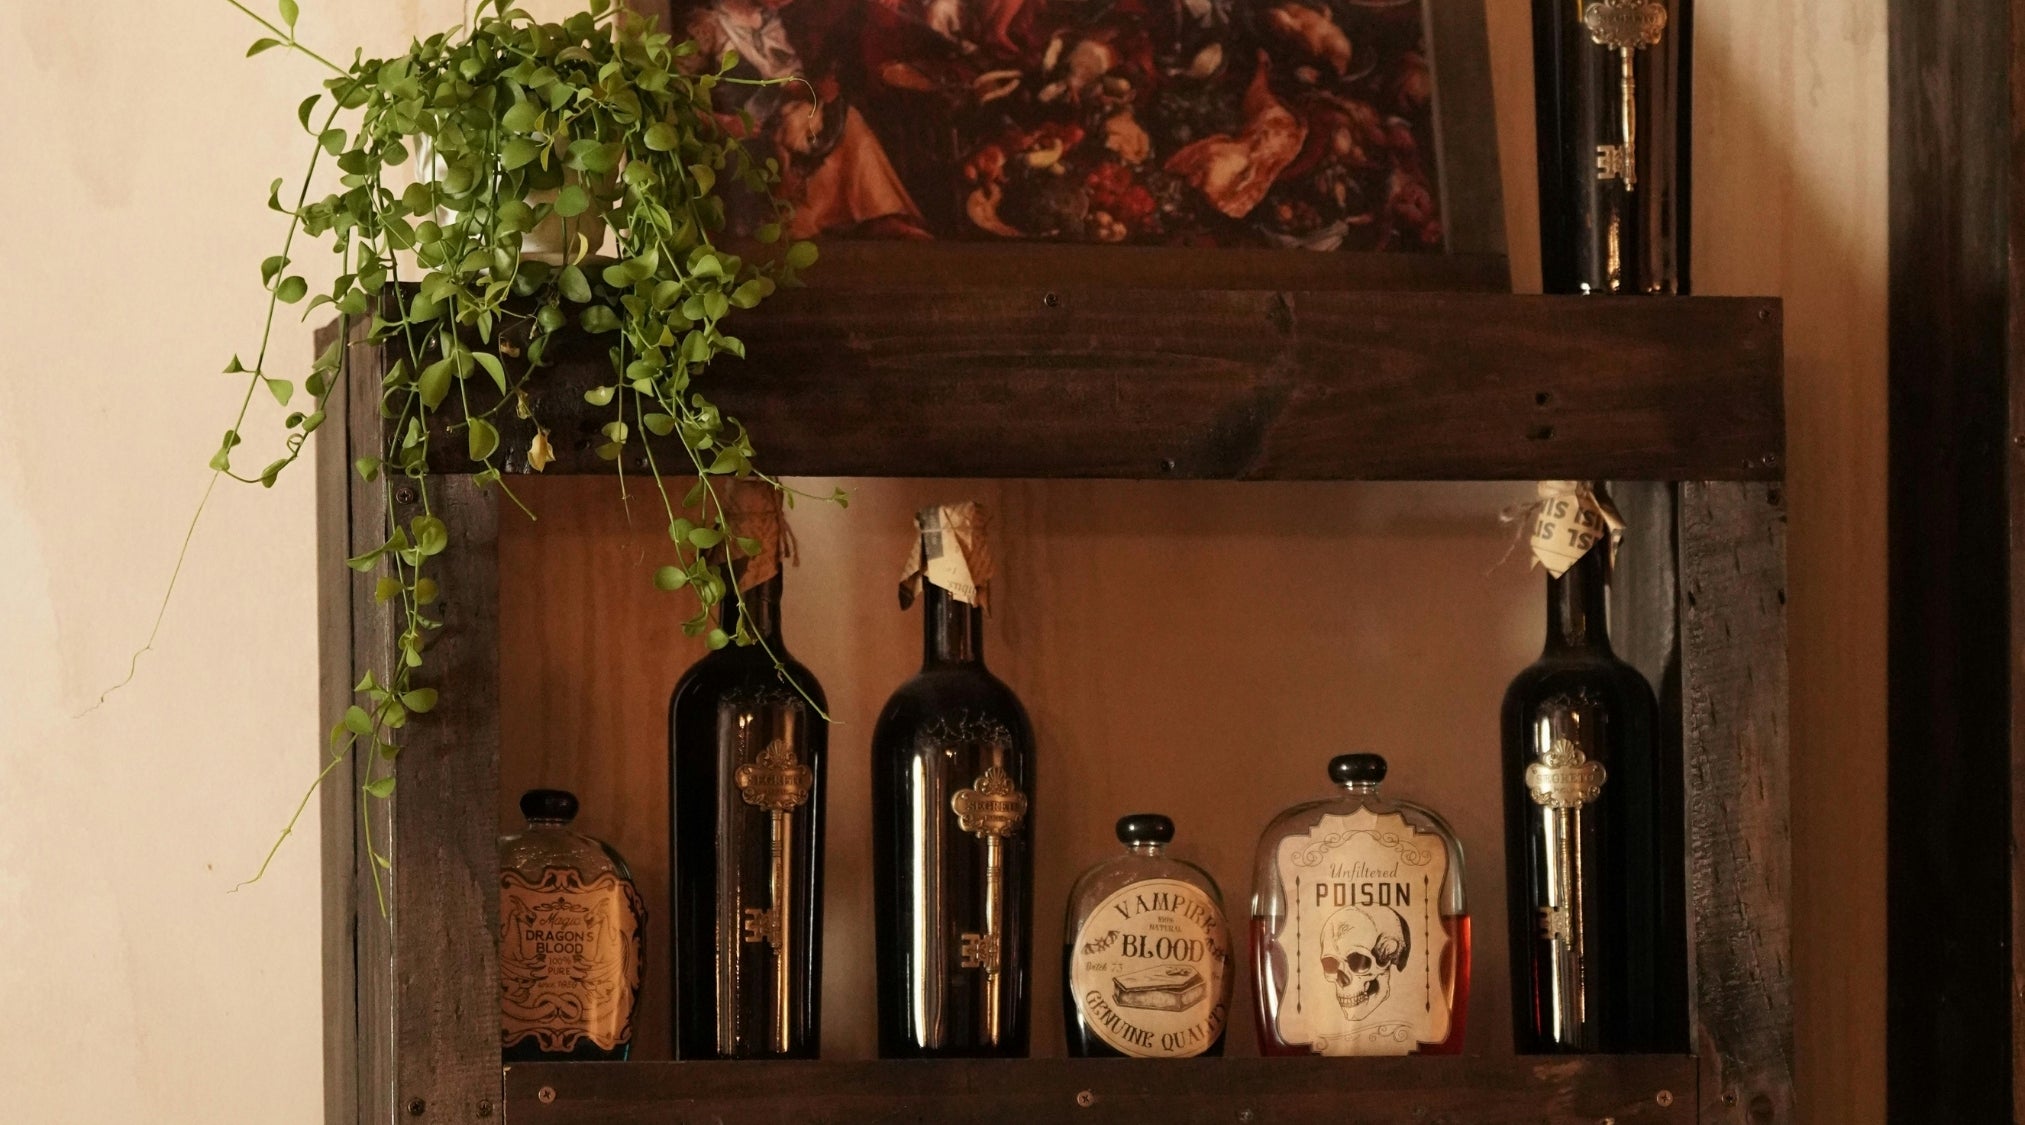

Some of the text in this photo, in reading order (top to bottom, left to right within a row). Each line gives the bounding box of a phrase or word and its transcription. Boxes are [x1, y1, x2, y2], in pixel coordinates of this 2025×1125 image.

[1329, 861, 1400, 881] Unfiltered
[1315, 882, 1411, 907] POISON
[539, 912, 581, 930] Magic
[1114, 892, 1217, 935] VAMPIRE
[536, 942, 584, 954] BLOOD
[1121, 934, 1205, 962] BLOOD
[547, 966, 571, 975] PURE
[548, 956, 571, 965] 100%
[1085, 989, 1155, 1048] GENUINE
